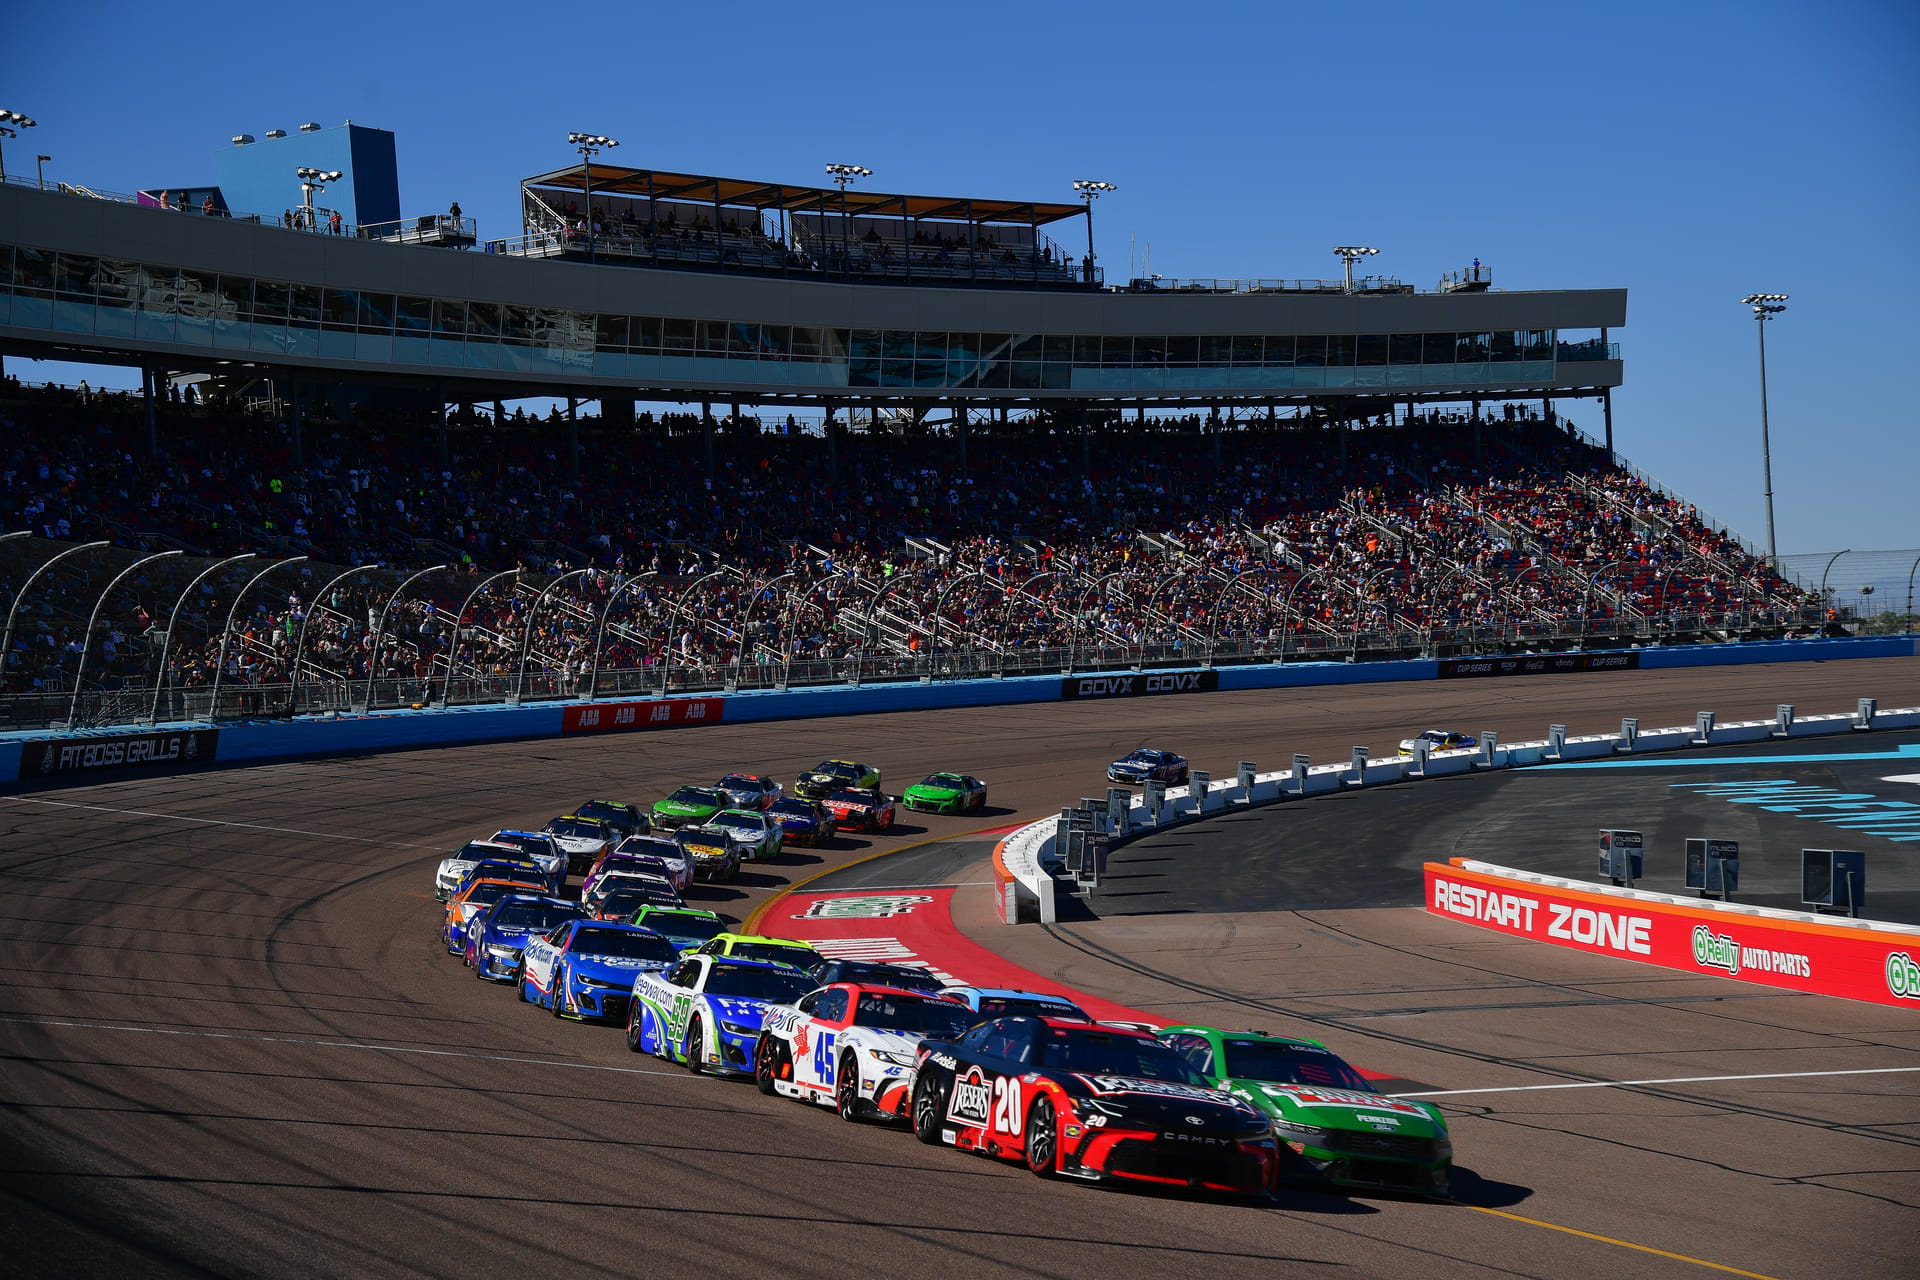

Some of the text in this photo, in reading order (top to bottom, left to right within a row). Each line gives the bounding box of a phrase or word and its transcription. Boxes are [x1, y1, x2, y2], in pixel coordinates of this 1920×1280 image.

[1079, 674, 1201, 696] GOVX GOVX
[579, 703, 707, 727] ABB ABB ABB ABB
[59, 738, 181, 769] PIT BOSS GRILLS
[1434, 878, 1652, 955] RESTART ZONE
[1692, 926, 1811, 978] O'Reilly AUTO PARTS
[667, 993, 692, 1043] 99
[814, 1032, 835, 1085] 45
[883, 1066, 903, 1076] 45
[953, 1083, 989, 1118] RESER'S
[994, 1075, 1022, 1135] 20
[1084, 1114, 1108, 1128] 20
[1163, 1132, 1231, 1147] CAMRY
